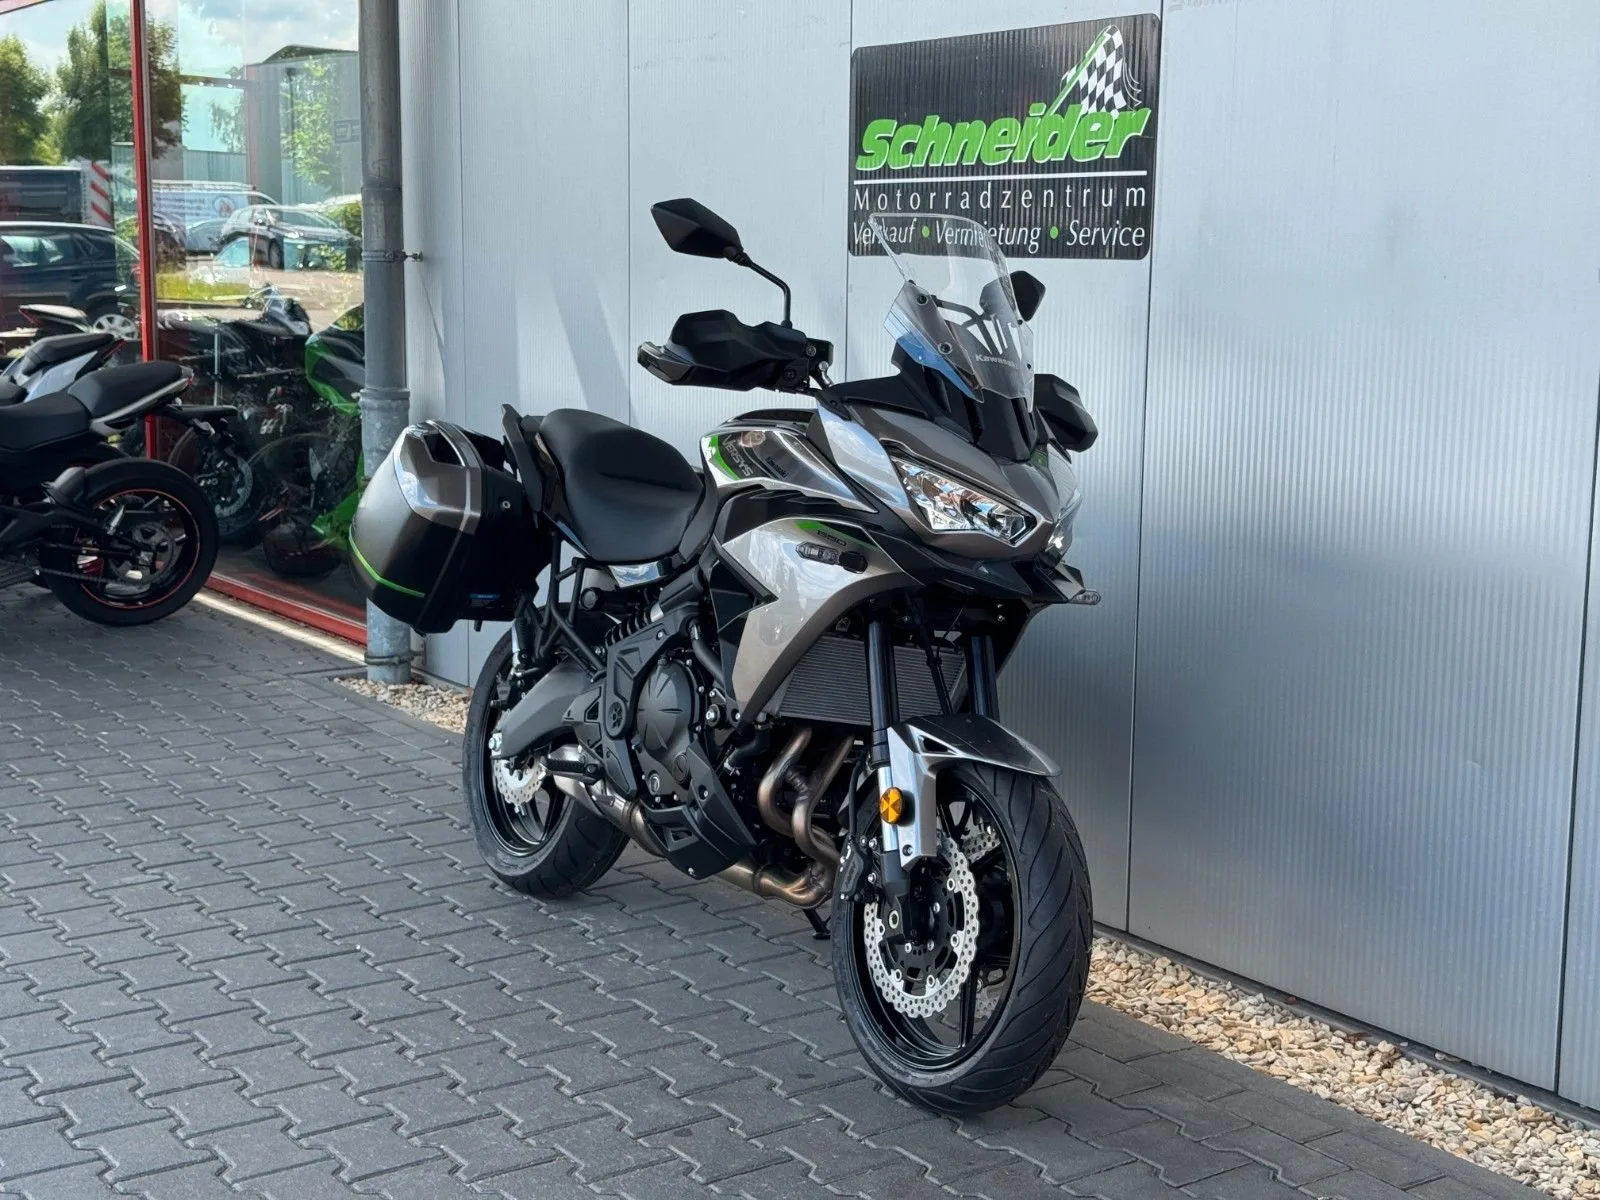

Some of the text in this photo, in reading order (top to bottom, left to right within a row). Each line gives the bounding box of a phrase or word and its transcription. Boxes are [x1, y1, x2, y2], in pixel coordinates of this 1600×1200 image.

[855, 103, 1151, 171] Schneider
[854, 182, 1146, 211] Motorradzentrum
[853, 217, 917, 246] Verkauf
[1066, 220, 1145, 247] Service
